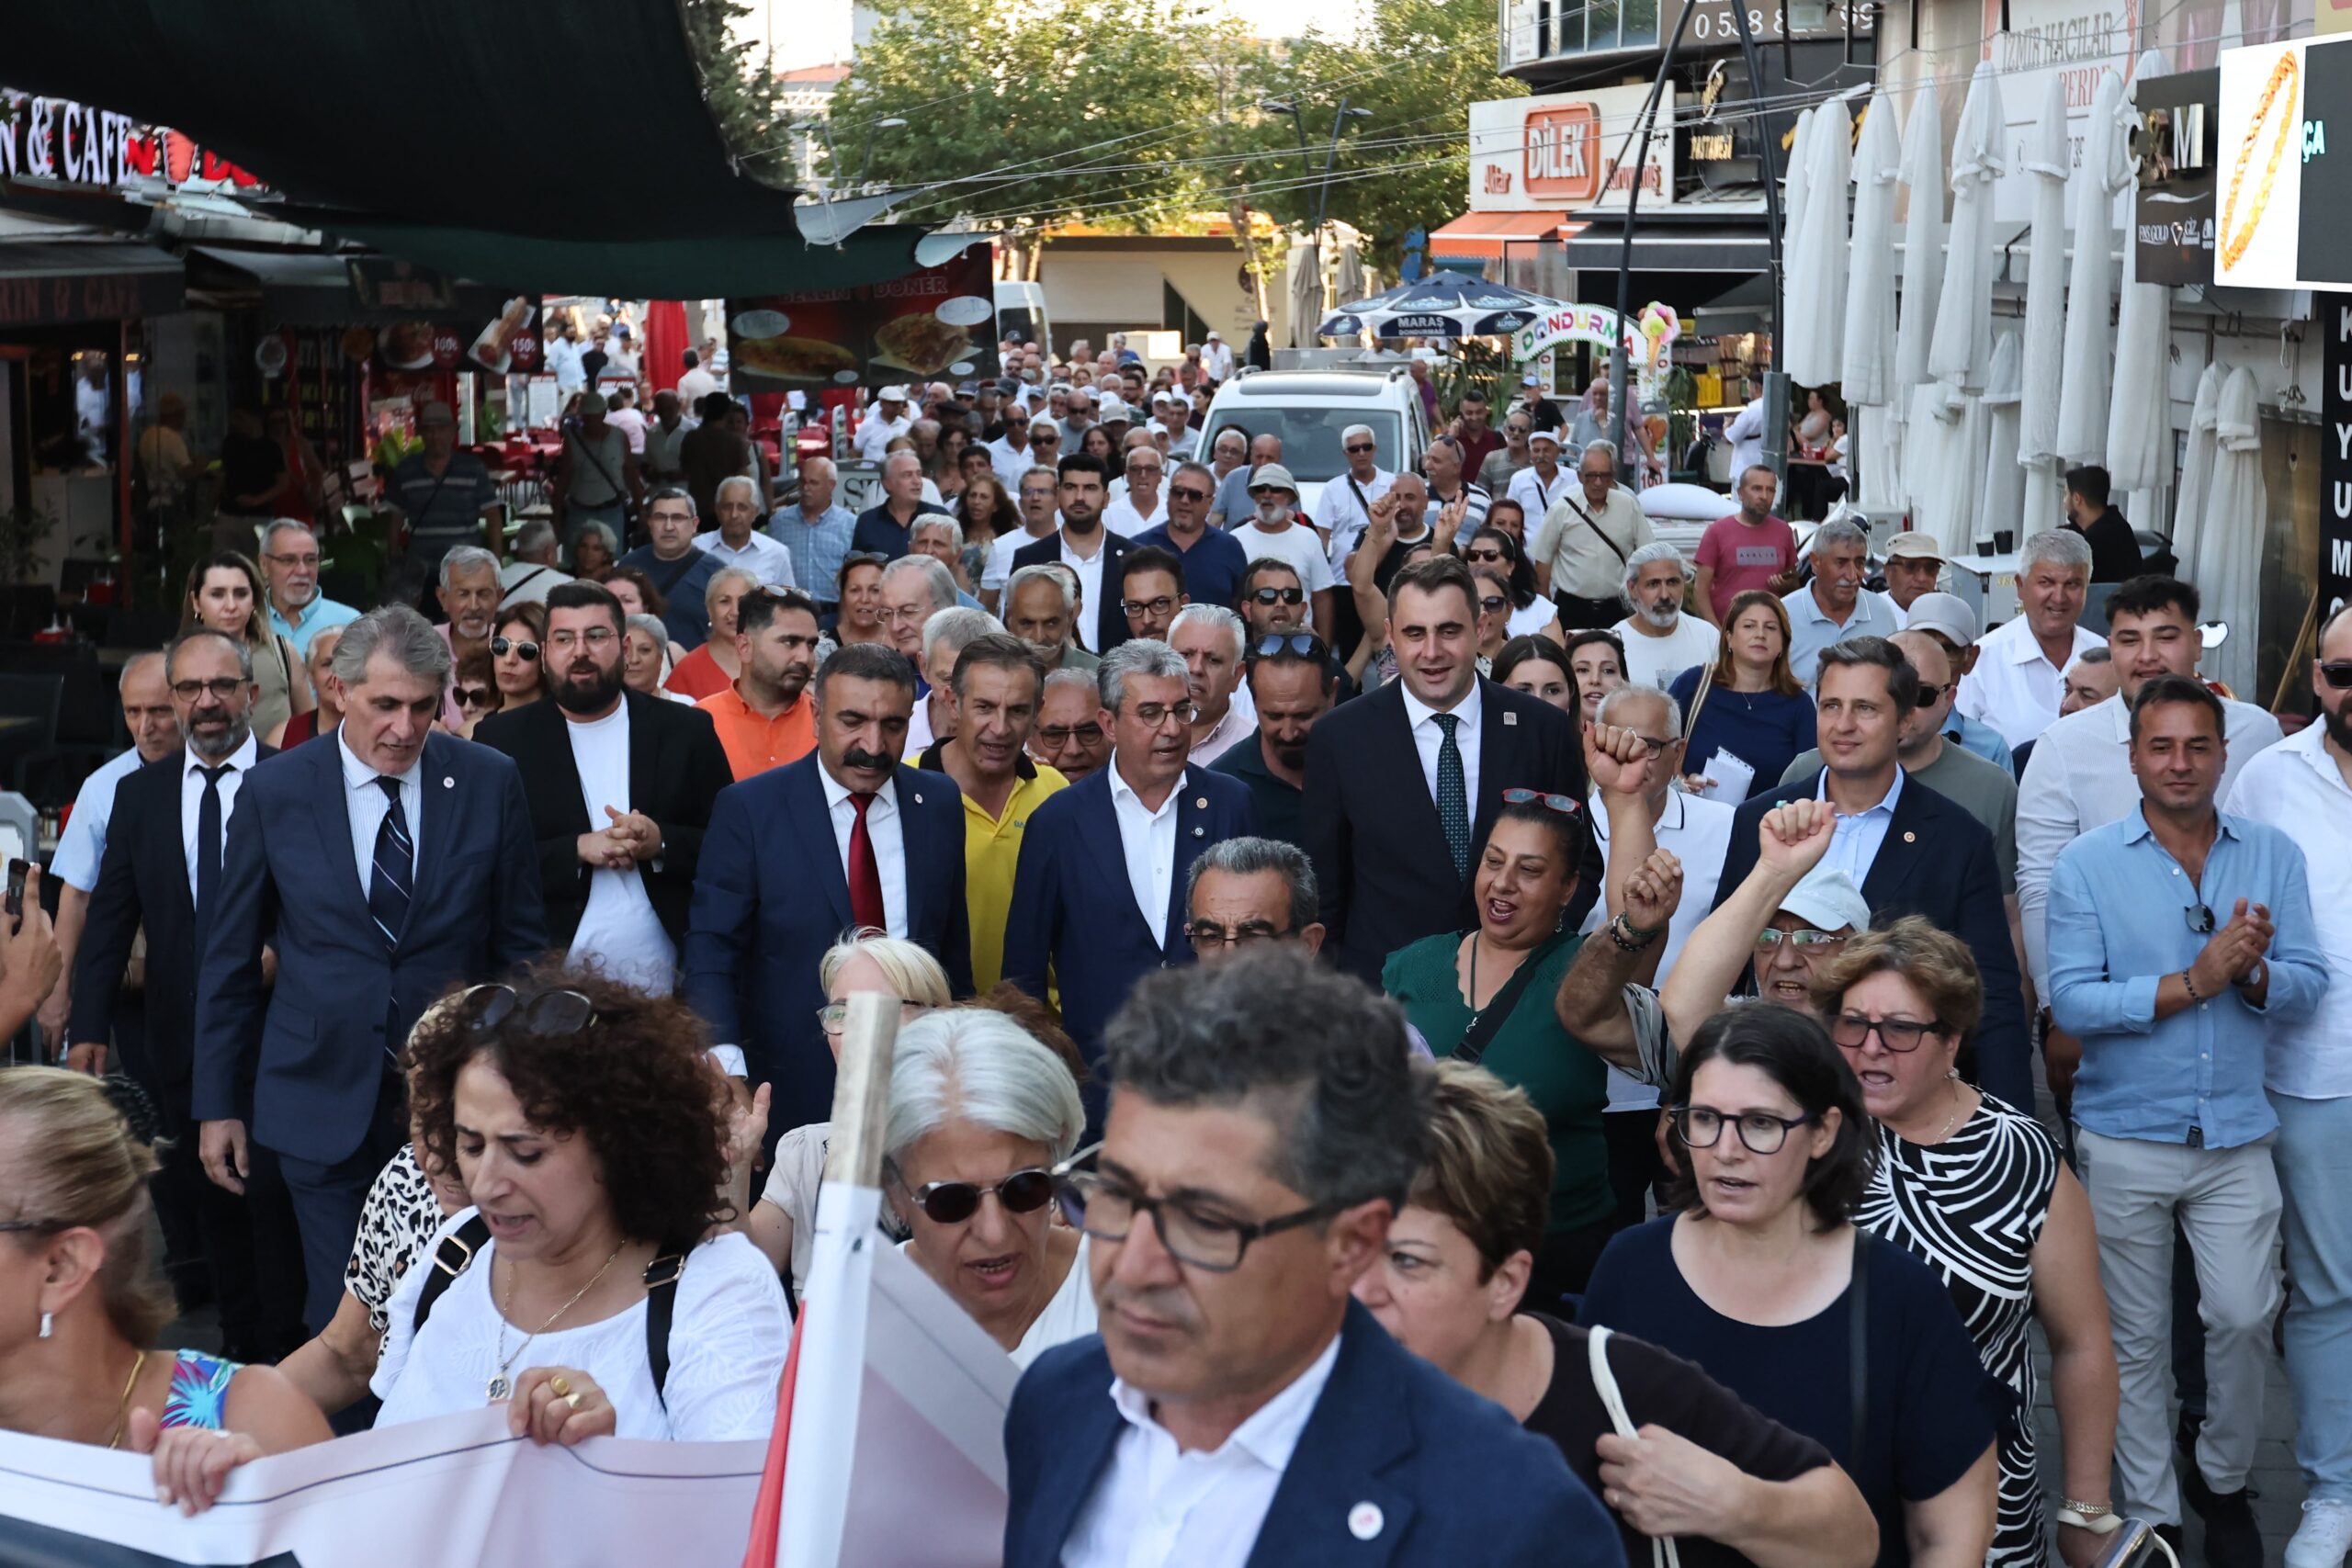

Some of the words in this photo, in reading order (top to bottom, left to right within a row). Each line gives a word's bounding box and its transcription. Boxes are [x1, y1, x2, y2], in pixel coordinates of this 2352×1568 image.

[1694, 14, 1710, 39] 0
[2058, 64, 2111, 108] PERD
[62, 101, 133, 185] CAFE
[1528, 116, 1589, 179] DİLEK
[1605, 154, 1664, 196] Kuruymiş
[1397, 317, 1444, 329] MARAŞ
